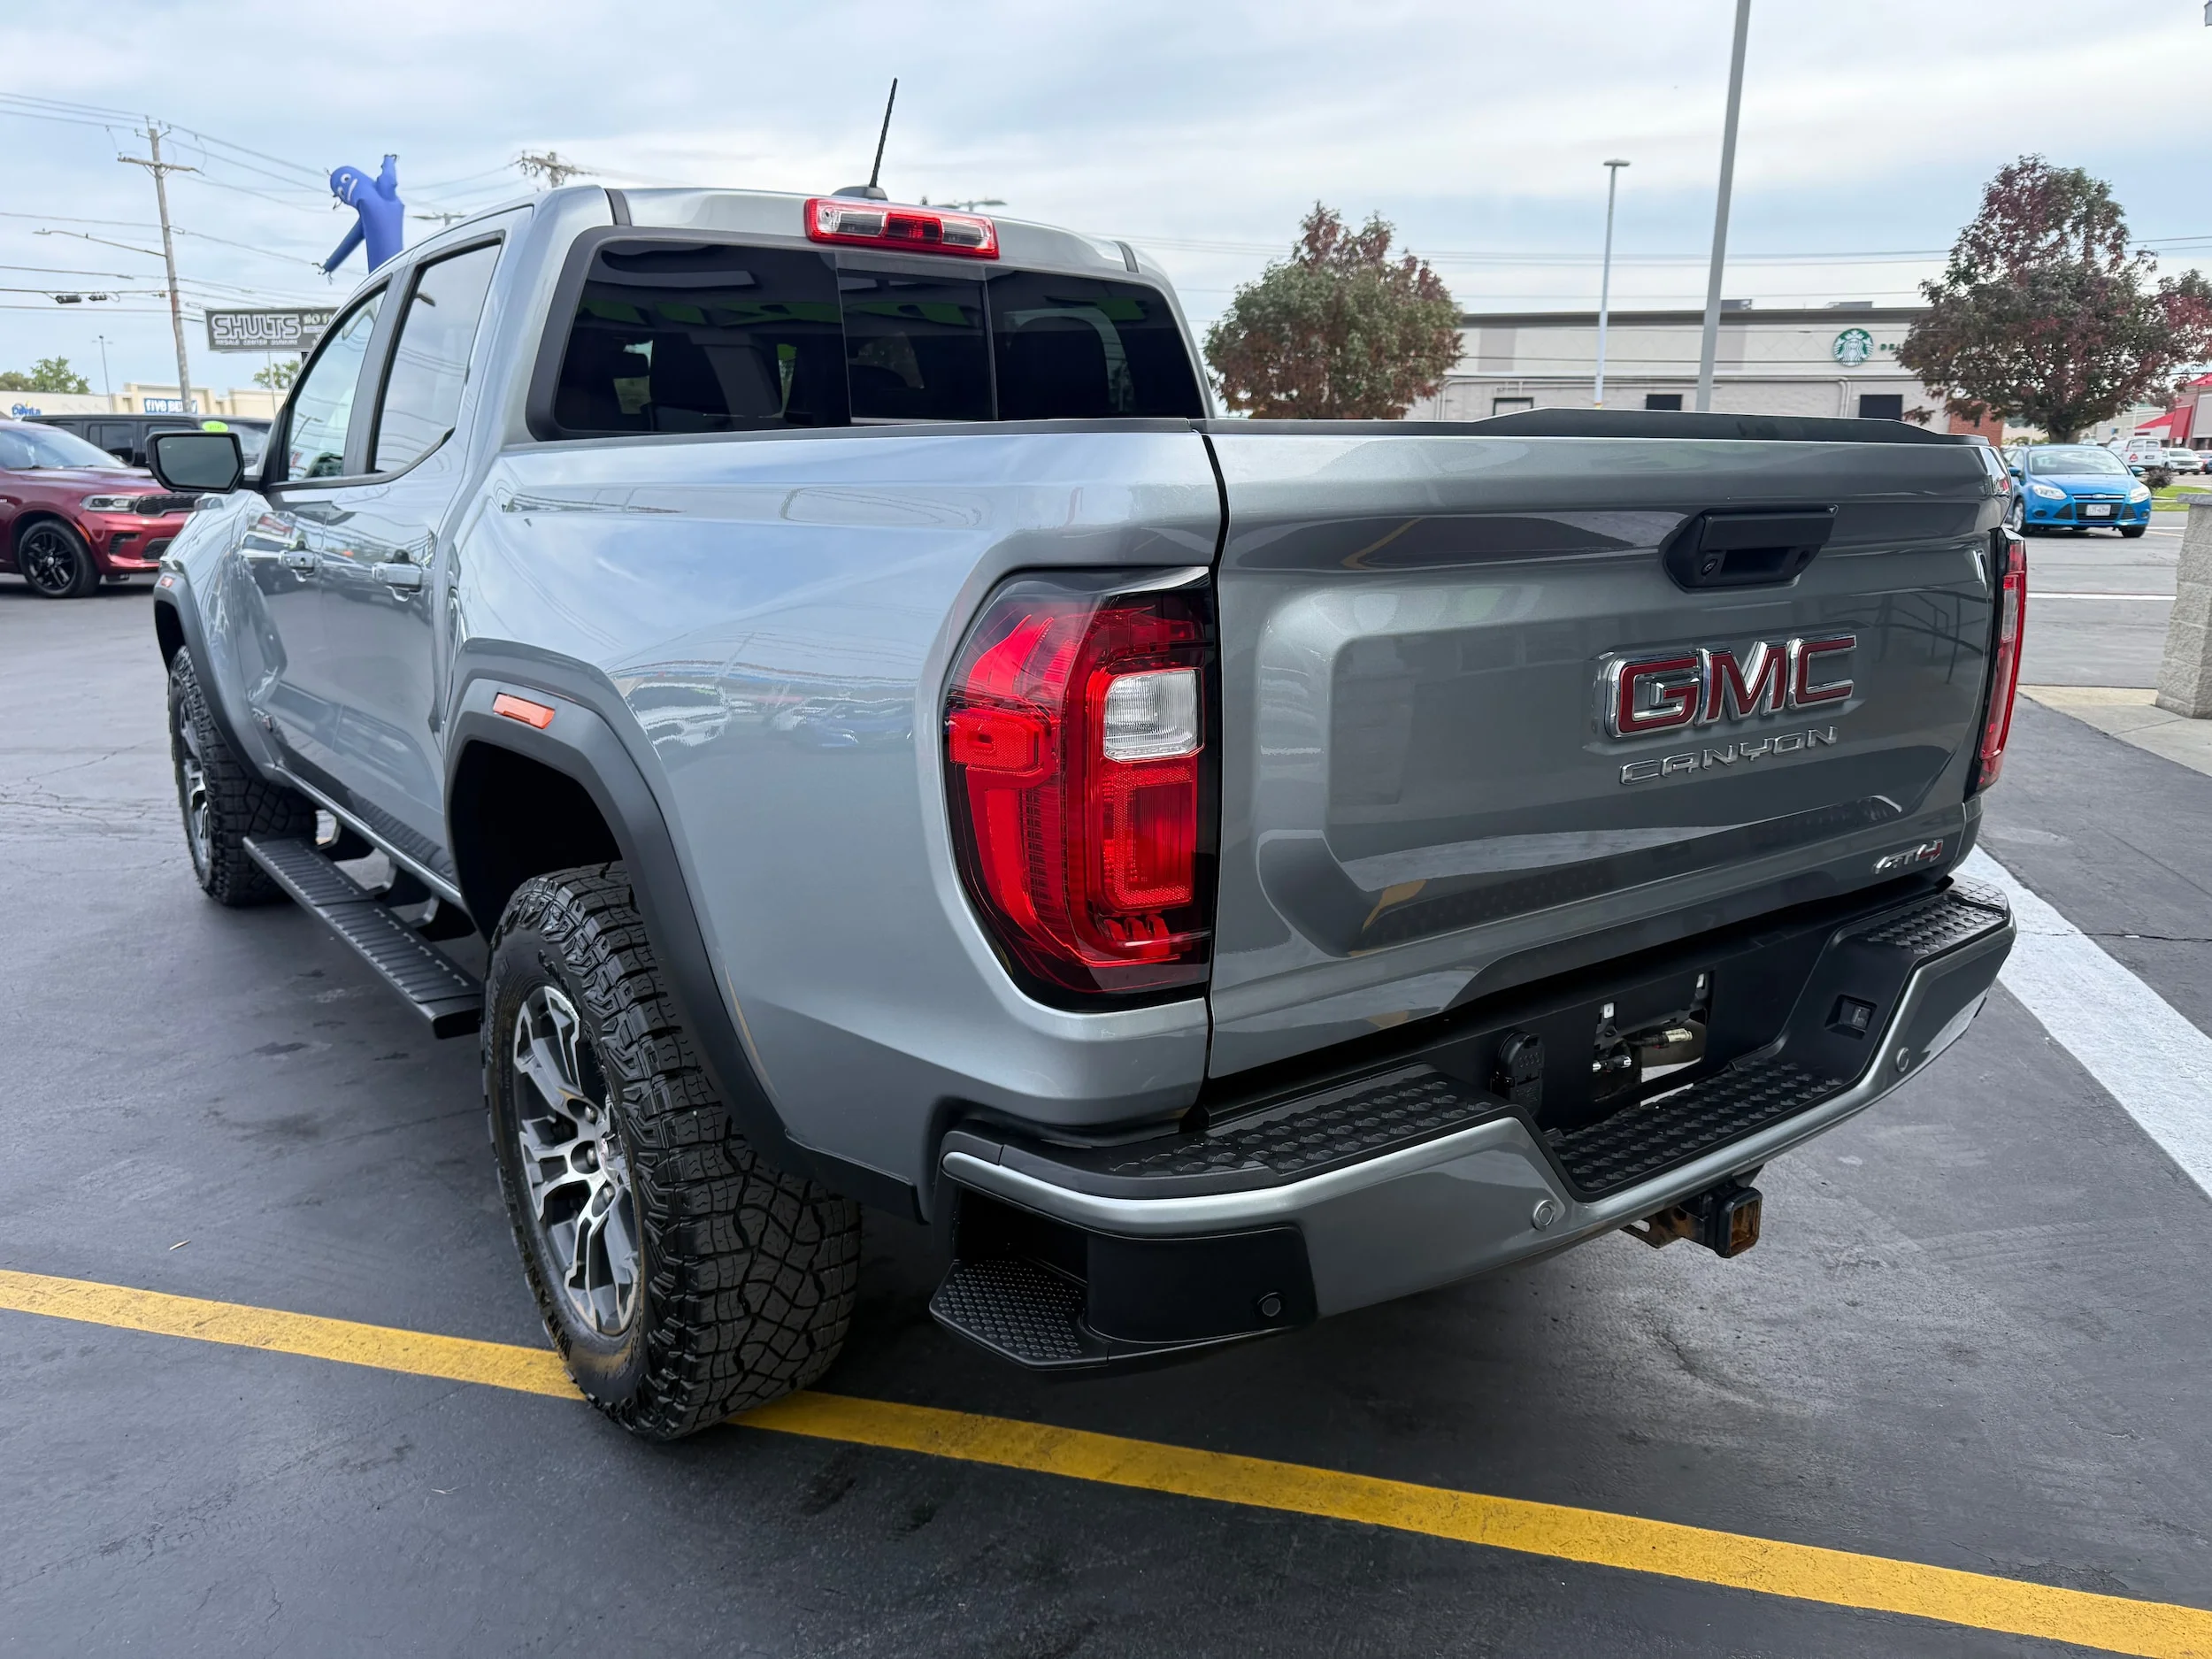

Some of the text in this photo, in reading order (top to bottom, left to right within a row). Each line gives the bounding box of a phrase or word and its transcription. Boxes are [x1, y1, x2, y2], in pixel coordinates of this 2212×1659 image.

[211, 313, 301, 339] SHULTS
[1604, 634, 1856, 738] GMC
[1620, 726, 1838, 786] CANYON
[1873, 839, 1944, 874] AT4
